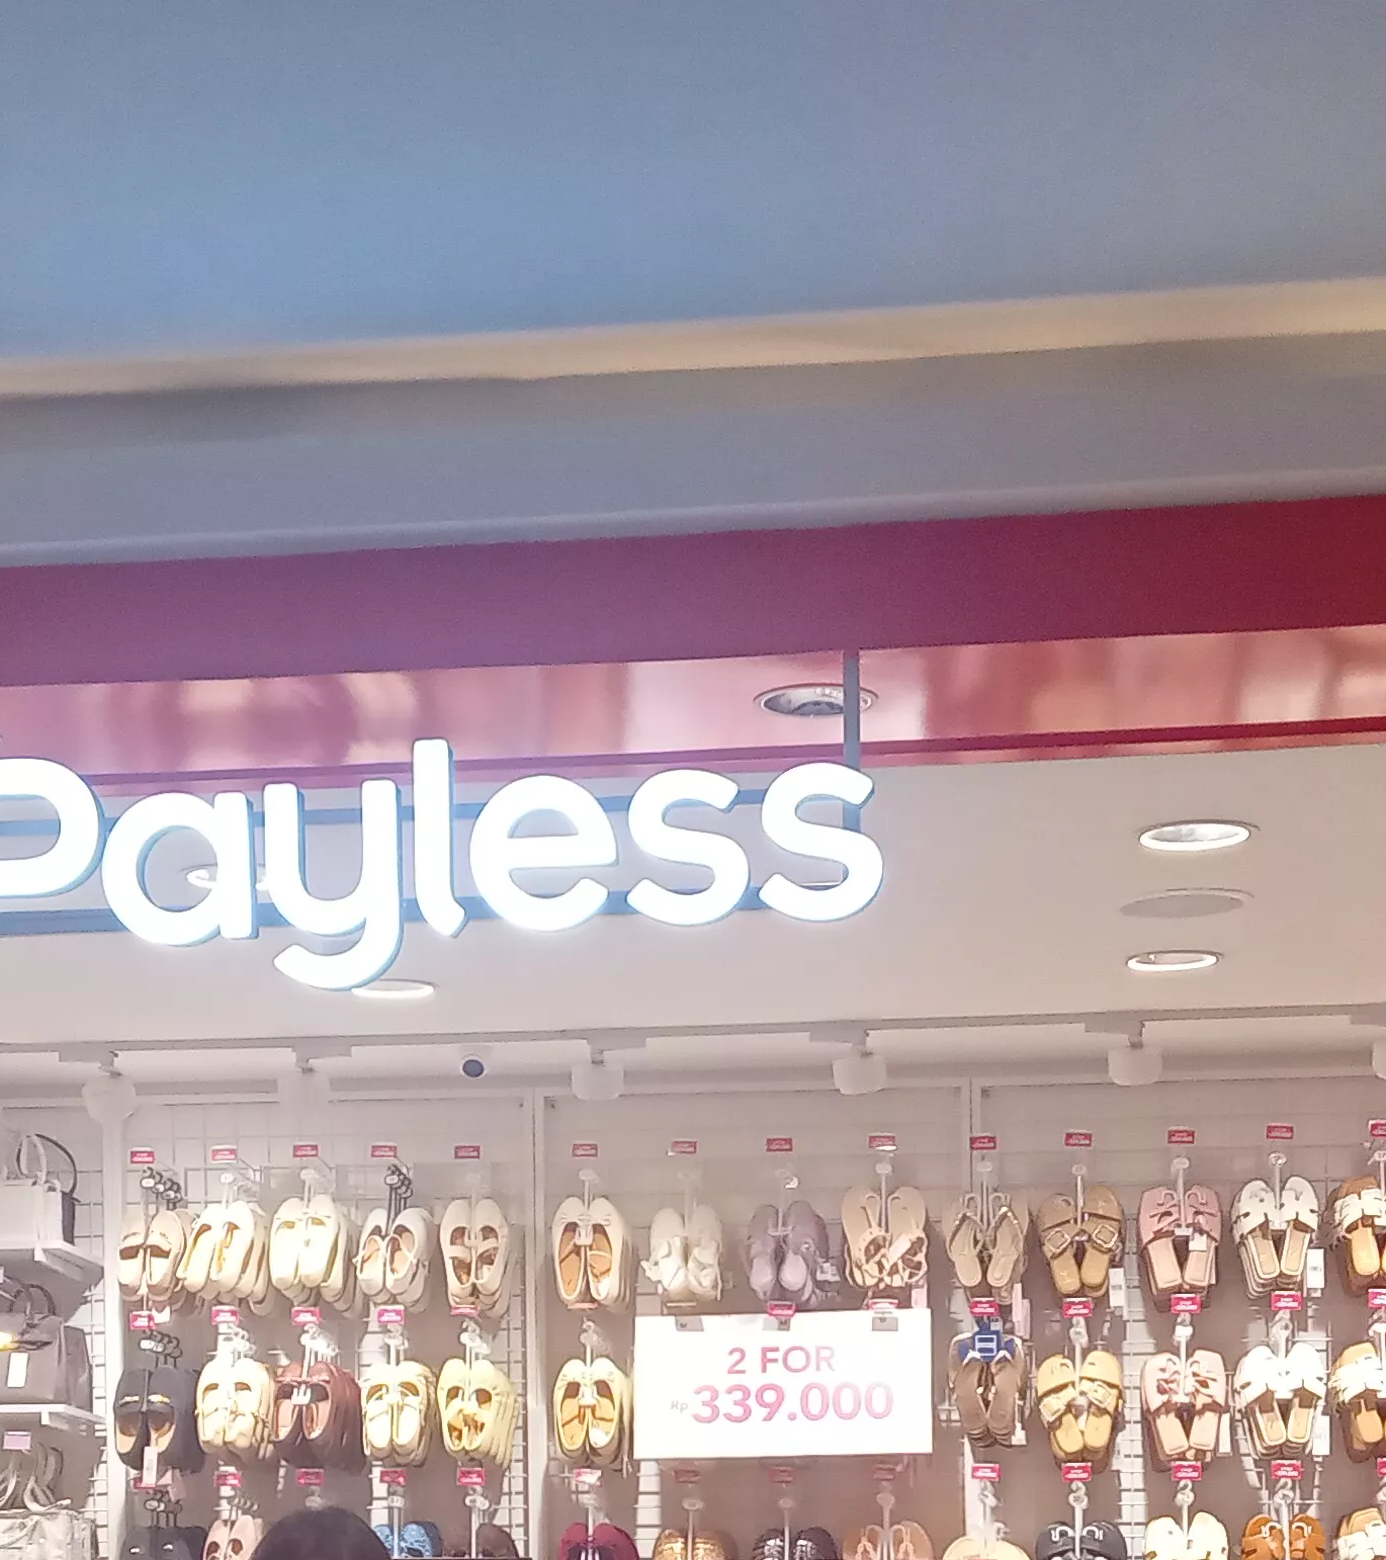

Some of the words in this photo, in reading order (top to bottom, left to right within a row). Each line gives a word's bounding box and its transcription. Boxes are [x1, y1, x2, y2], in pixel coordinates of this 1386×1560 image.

[726, 1347, 747, 1375] 2
[760, 1345, 836, 1374] FOR
[670, 1400, 689, 1414] Rp
[691, 1381, 894, 1424] 339.000
